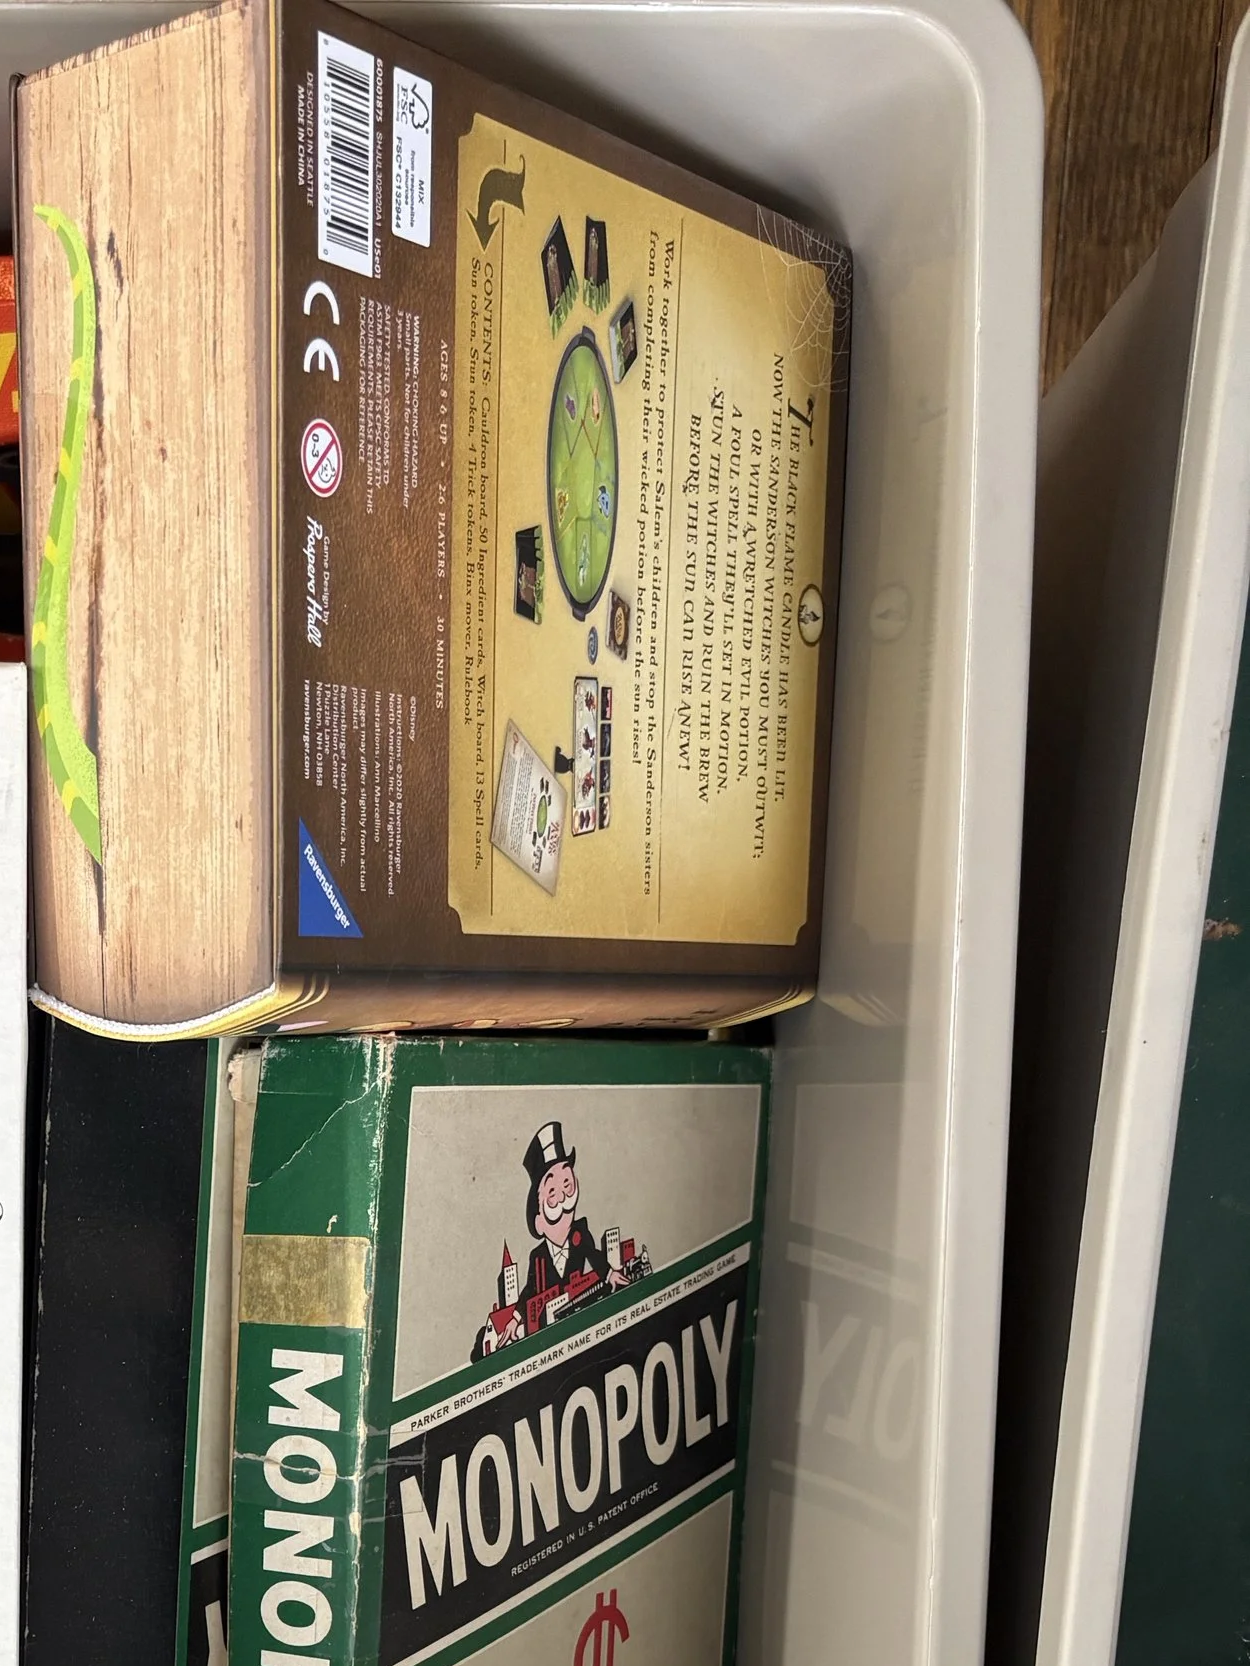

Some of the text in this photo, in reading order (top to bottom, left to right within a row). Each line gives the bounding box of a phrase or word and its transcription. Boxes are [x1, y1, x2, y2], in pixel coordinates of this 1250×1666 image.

[472, 258, 480, 287] Sun
[649, 231, 659, 276] from
[483, 263, 493, 385] CONTENTS:
[642, 285, 654, 390] completing
[441, 389, 447, 397] 8
[470, 347, 478, 383] Stun
[440, 424, 447, 444] UP
[469, 443, 476, 452] 4
[481, 397, 490, 468] Cauldron
[643, 399, 652, 442] their
[468, 458, 476, 497] Trick
[641, 451, 649, 514] wicked
[480, 526, 488, 543] 50
[637, 520, 647, 578] potion
[467, 562, 475, 595] Binx
[477, 549, 487, 622] Ingredient
[644, 241, 674, 894] Work together to protect Salem's children and stop the Sanderson sisters
[678, 415, 701, 770] BEFORE THE SUN CAN RISE ANEW!
[699, 387, 724, 802] STUN THE WITCHES AND RUIN THE BREW
[304, 597, 325, 647] Hall
[437, 616, 444, 631] 30
[636, 587, 646, 643] before
[718, 405, 742, 793] A FOUL SPELL THEY'LL SET IN MOTION.
[738, 429, 762, 781] OR WITH A WRETCHED EVIL POTION,
[754, 354, 783, 858] NOW THE SANDERSON WITCHES YOU MUST OUTWIT;
[775, 399, 814, 801] THE BLACK FLAME CANDLE HAS BEEN LIT.
[465, 656, 473, 724] Rulebook
[635, 652, 644, 677] the
[477, 675, 485, 716] Witch
[633, 720, 641, 764] rises!
[477, 772, 484, 784] 13
[474, 789, 484, 825] Spell
[302, 844, 352, 930] Ravensburger
[410, 1253, 737, 1432] PARKER BROTHERS' TRADE-MARK NAME FOR ITS REAL ESTATE TRADING GAME
[398, 1300, 740, 1609] MONOPOLY
[511, 1540, 564, 1577] REGISTERED
[566, 1532, 576, 1544] IN
[597, 1500, 629, 1526] PATENT
[630, 1482, 659, 1505] OFFICE
